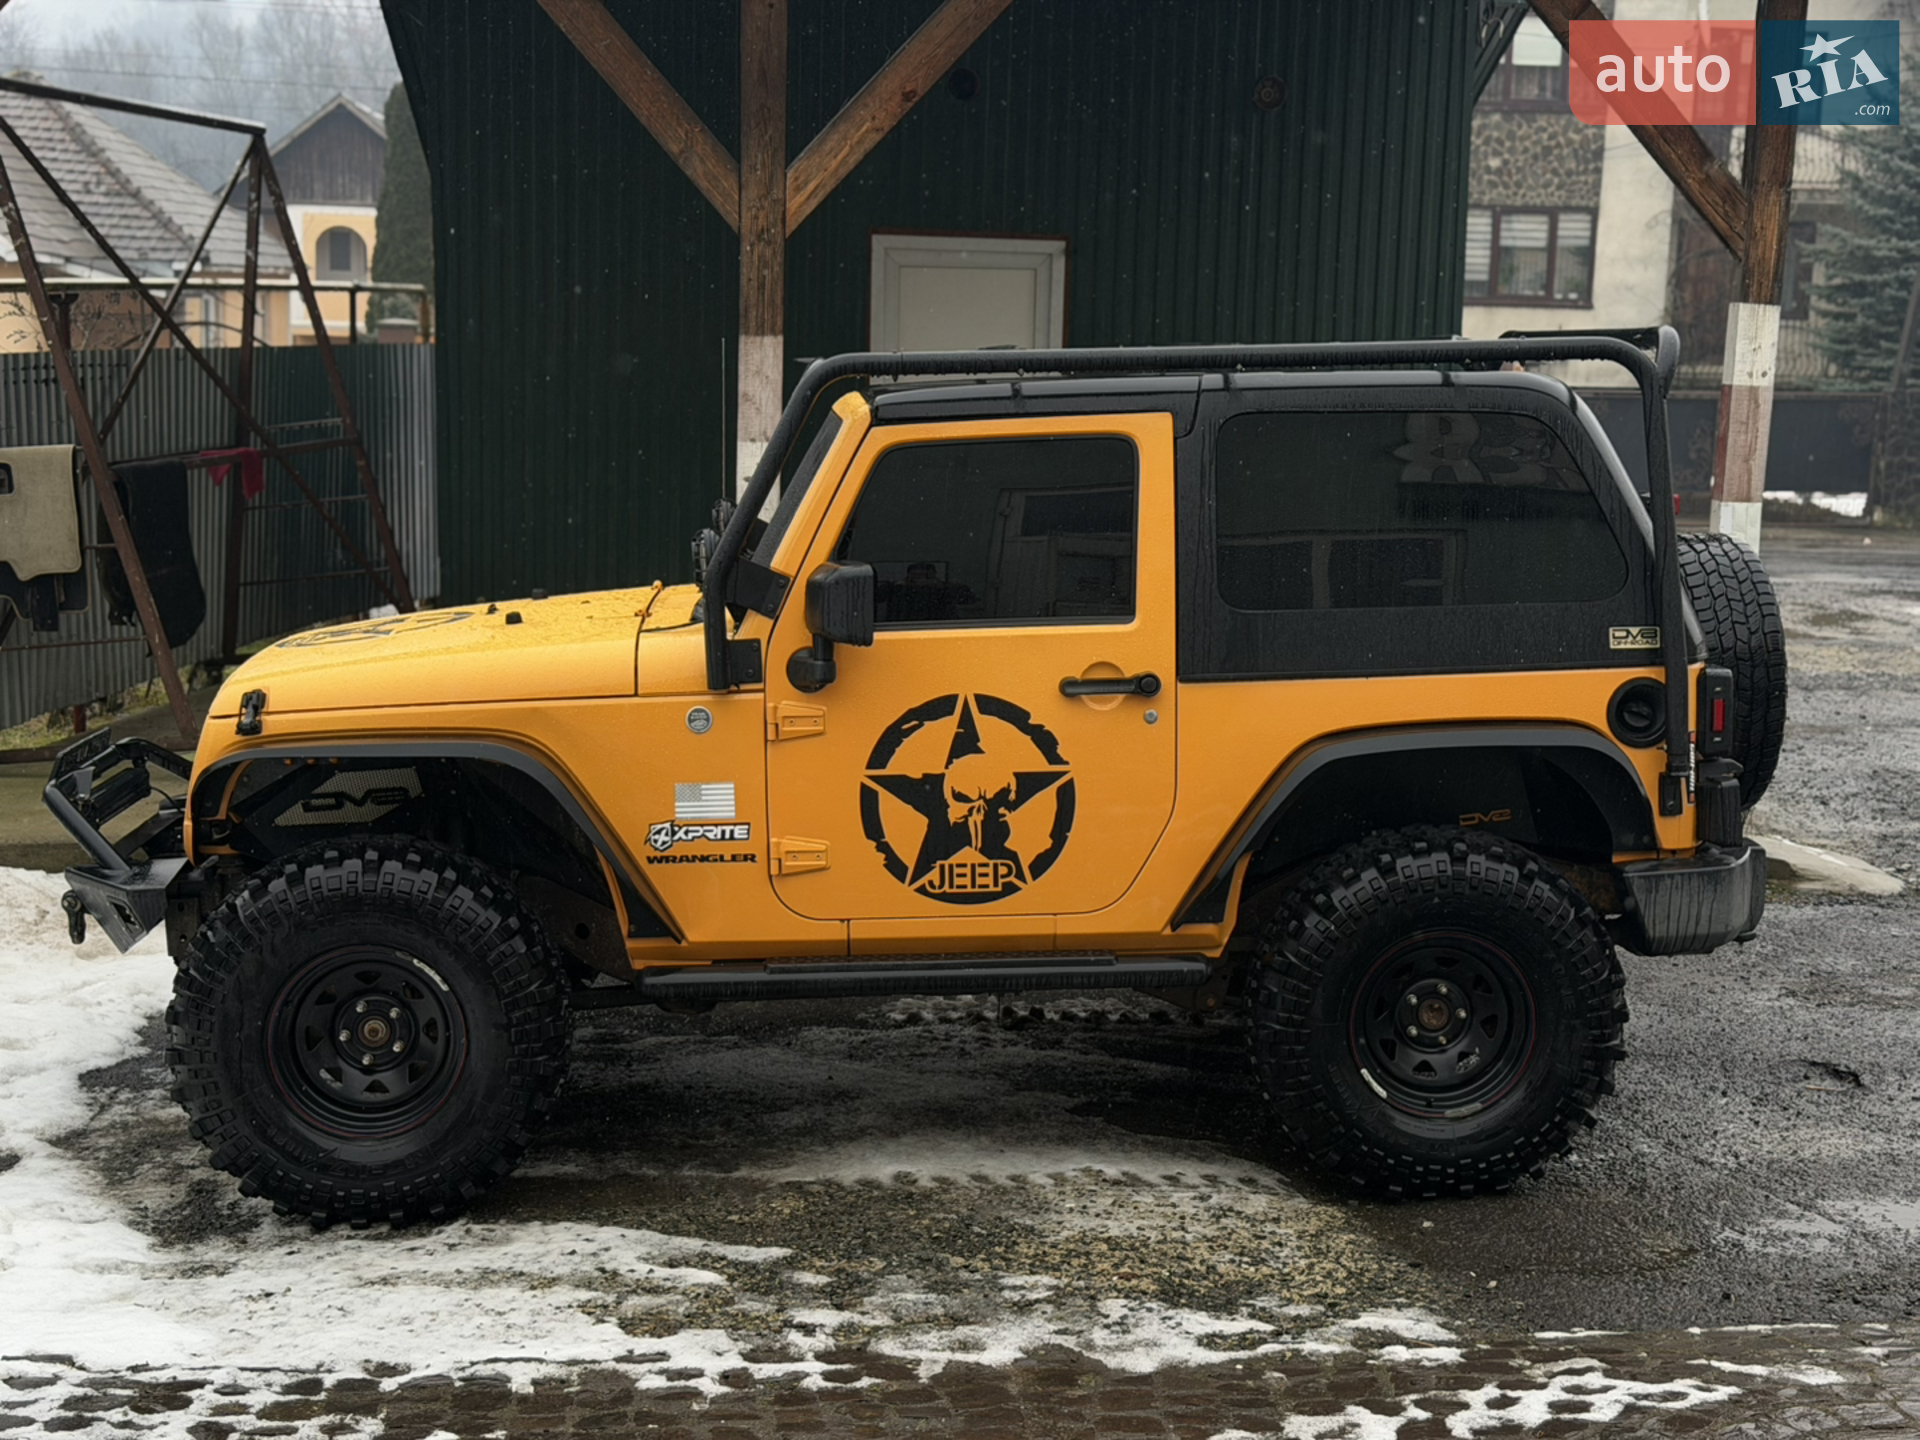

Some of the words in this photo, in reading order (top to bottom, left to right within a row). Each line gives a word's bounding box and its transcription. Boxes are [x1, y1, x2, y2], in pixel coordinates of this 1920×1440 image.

[671, 824, 750, 840] XPRITE
[645, 852, 758, 865] WRANGLER
[926, 861, 1016, 891] JEEP
